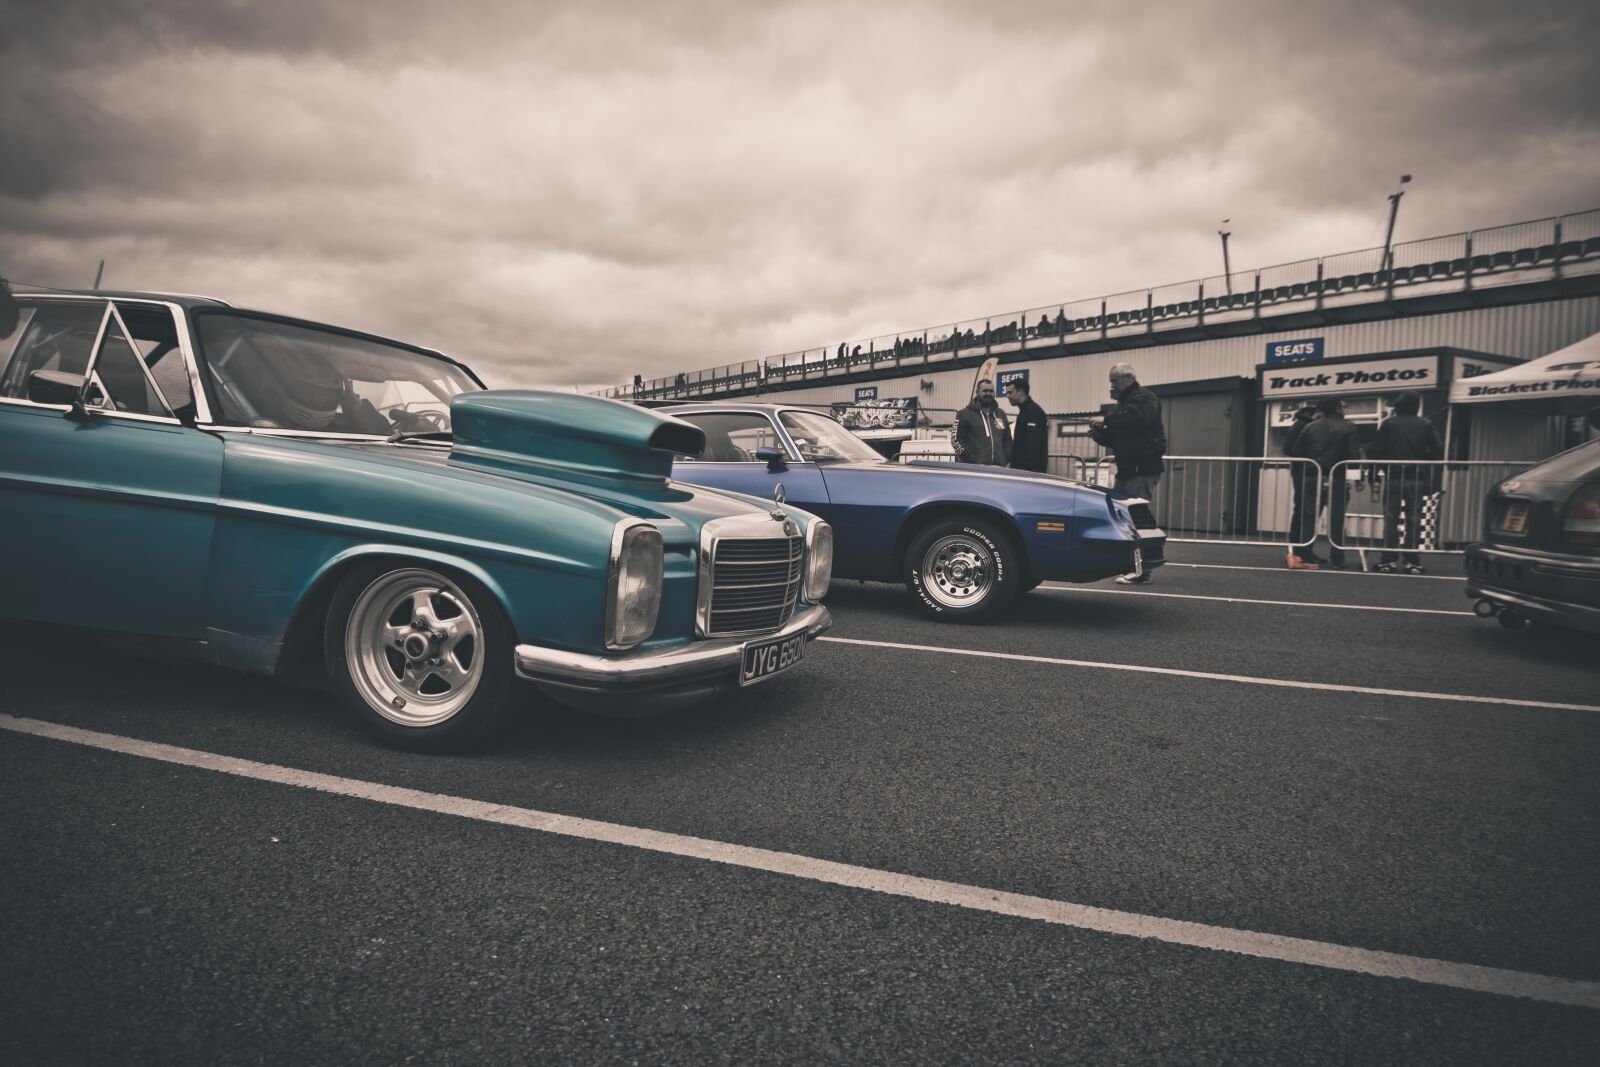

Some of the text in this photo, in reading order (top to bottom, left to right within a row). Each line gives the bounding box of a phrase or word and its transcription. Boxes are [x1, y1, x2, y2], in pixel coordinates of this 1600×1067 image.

[1274, 342, 1315, 357] SEATS
[1269, 368, 1430, 390] Track Photos
[1467, 381, 1549, 396] Blackett
[858, 389, 875, 398] SEATS
[963, 526, 1004, 582] COOPER COBRA
[917, 586, 943, 613] RADIAL
[745, 644, 779, 679] JYG
